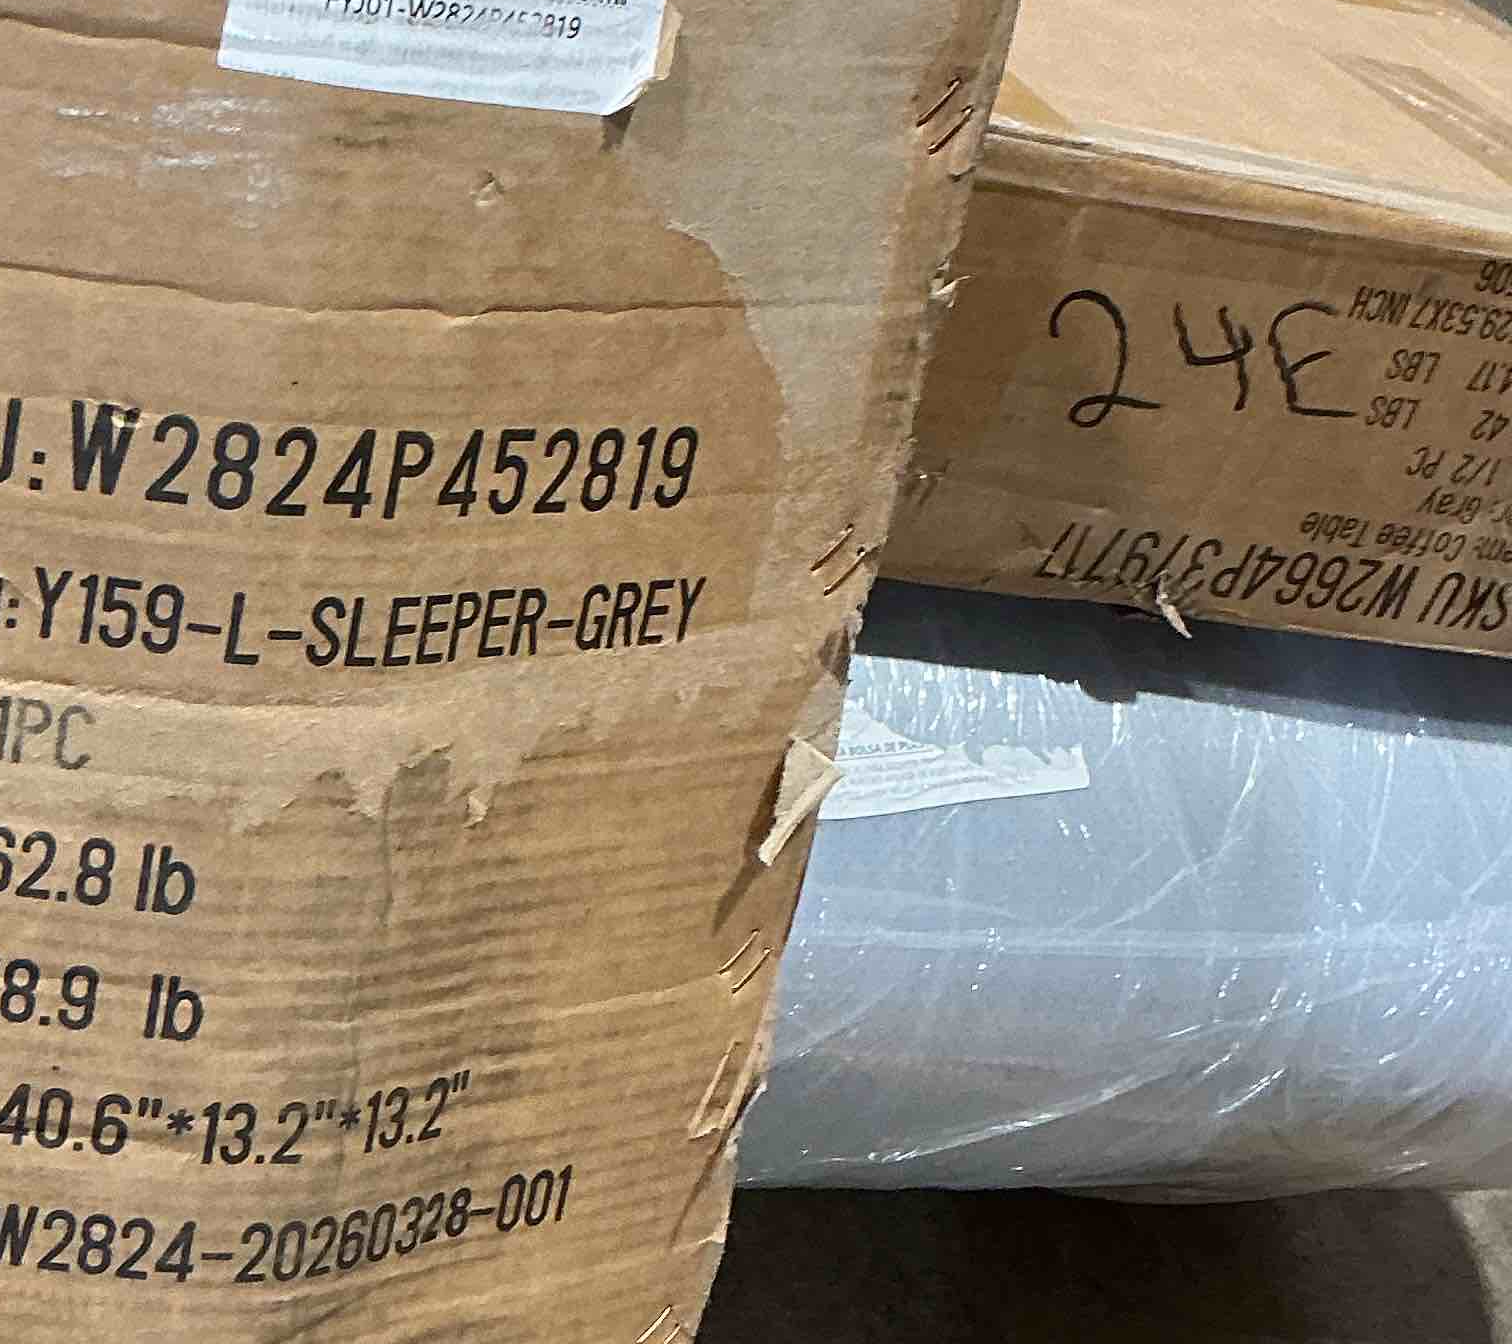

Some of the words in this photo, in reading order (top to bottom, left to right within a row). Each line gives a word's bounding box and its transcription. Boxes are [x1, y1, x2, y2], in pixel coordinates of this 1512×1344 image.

[1347, 285, 1412, 327] INCH
[1409, 297, 1512, 344] 29.53X7
[1384, 348, 1441, 384] LBS
[1365, 395, 1422, 430] LBS
[1405, 444, 1446, 479] PC
[1450, 453, 1502, 487] 1/2
[1416, 486, 1482, 524] Gray
[1300, 511, 1371, 548] Table
[1375, 522, 1467, 562] Coffee
[1416, 572, 1509, 632] SKU
[134, 842, 196, 915] lb
[143, 973, 205, 1041] lb
